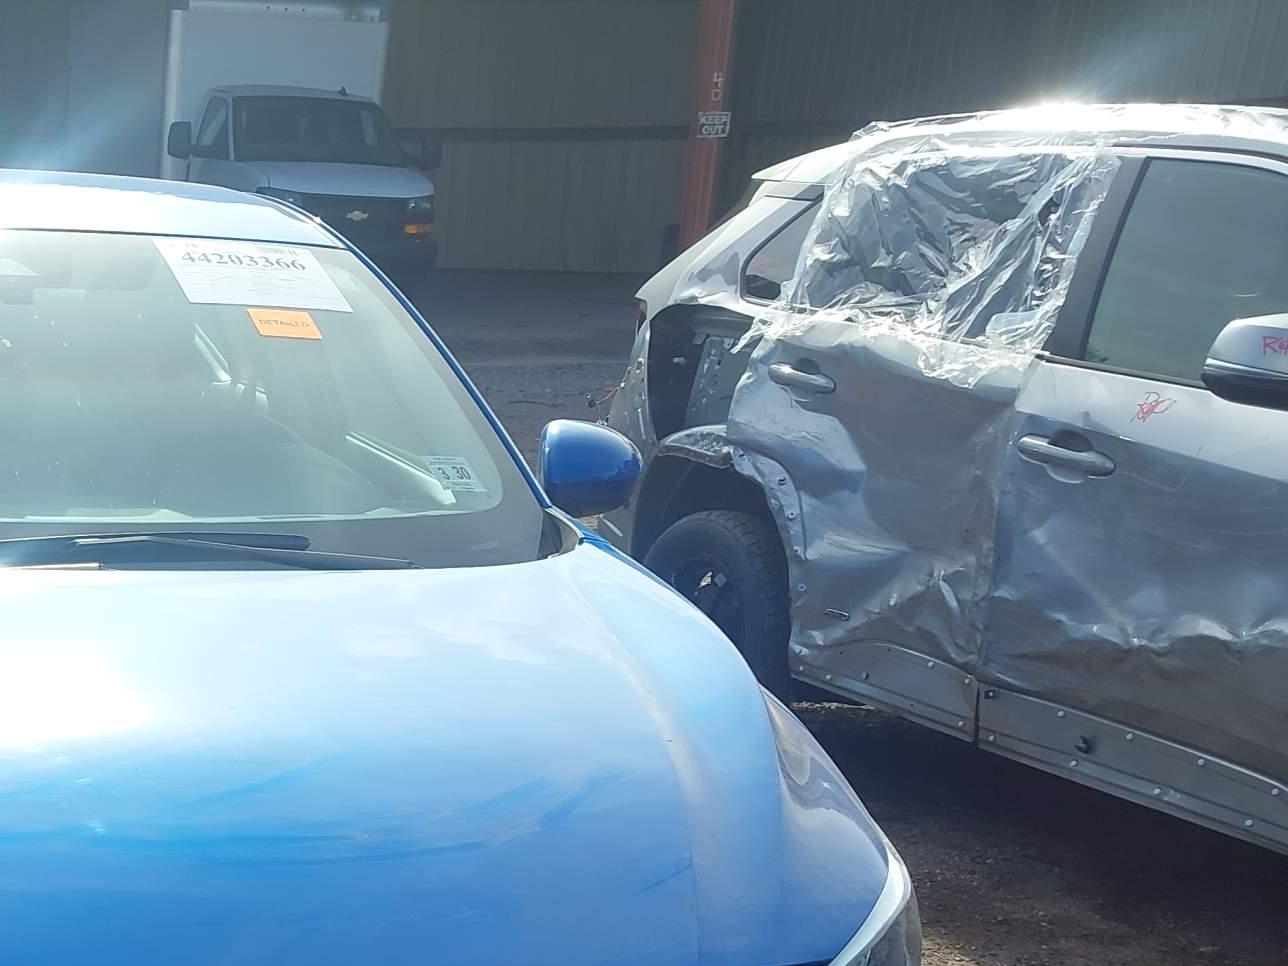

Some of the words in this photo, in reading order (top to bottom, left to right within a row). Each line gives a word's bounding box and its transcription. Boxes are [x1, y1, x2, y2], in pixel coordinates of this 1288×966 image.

[700, 115, 728, 124] KEEP
[702, 126, 724, 135] OUT
[181, 251, 307, 271] 44203366
[258, 319, 310, 328] DETAILED
[437, 467, 450, 480] 3
[452, 466, 471, 480] 30
